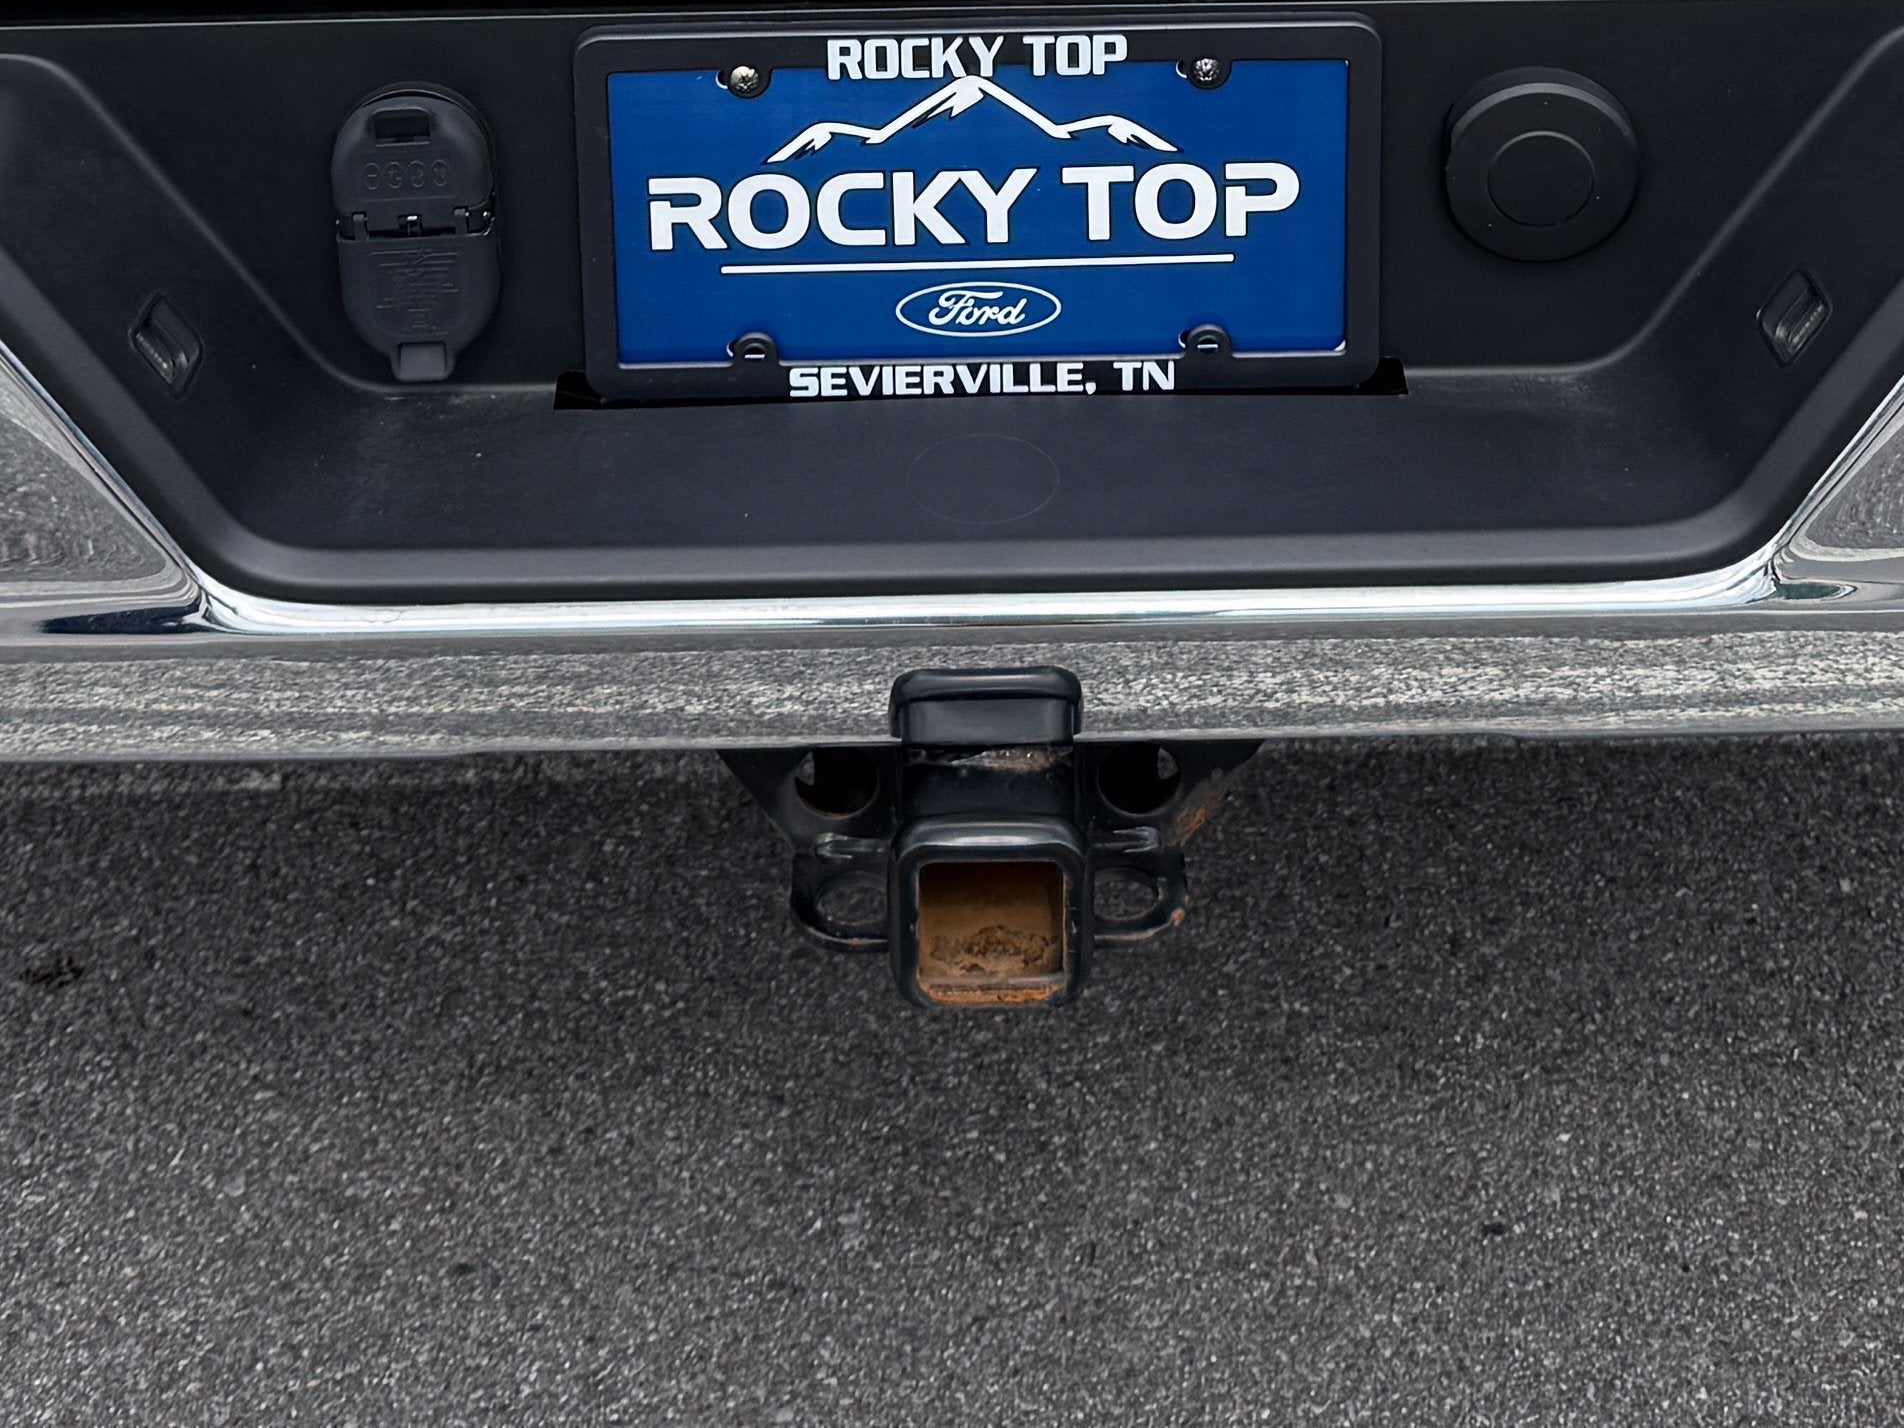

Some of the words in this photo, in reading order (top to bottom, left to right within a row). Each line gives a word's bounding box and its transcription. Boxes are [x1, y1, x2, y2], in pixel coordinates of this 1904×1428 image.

[827, 35, 1005, 82] ROCKY
[1022, 33, 1129, 77] TOP
[648, 167, 1038, 252] ROCKY
[1060, 161, 1301, 242] TOP
[928, 289, 1027, 329] Ford
[788, 361, 1098, 398] SEVIERVILLE,
[1112, 359, 1176, 392] TN
